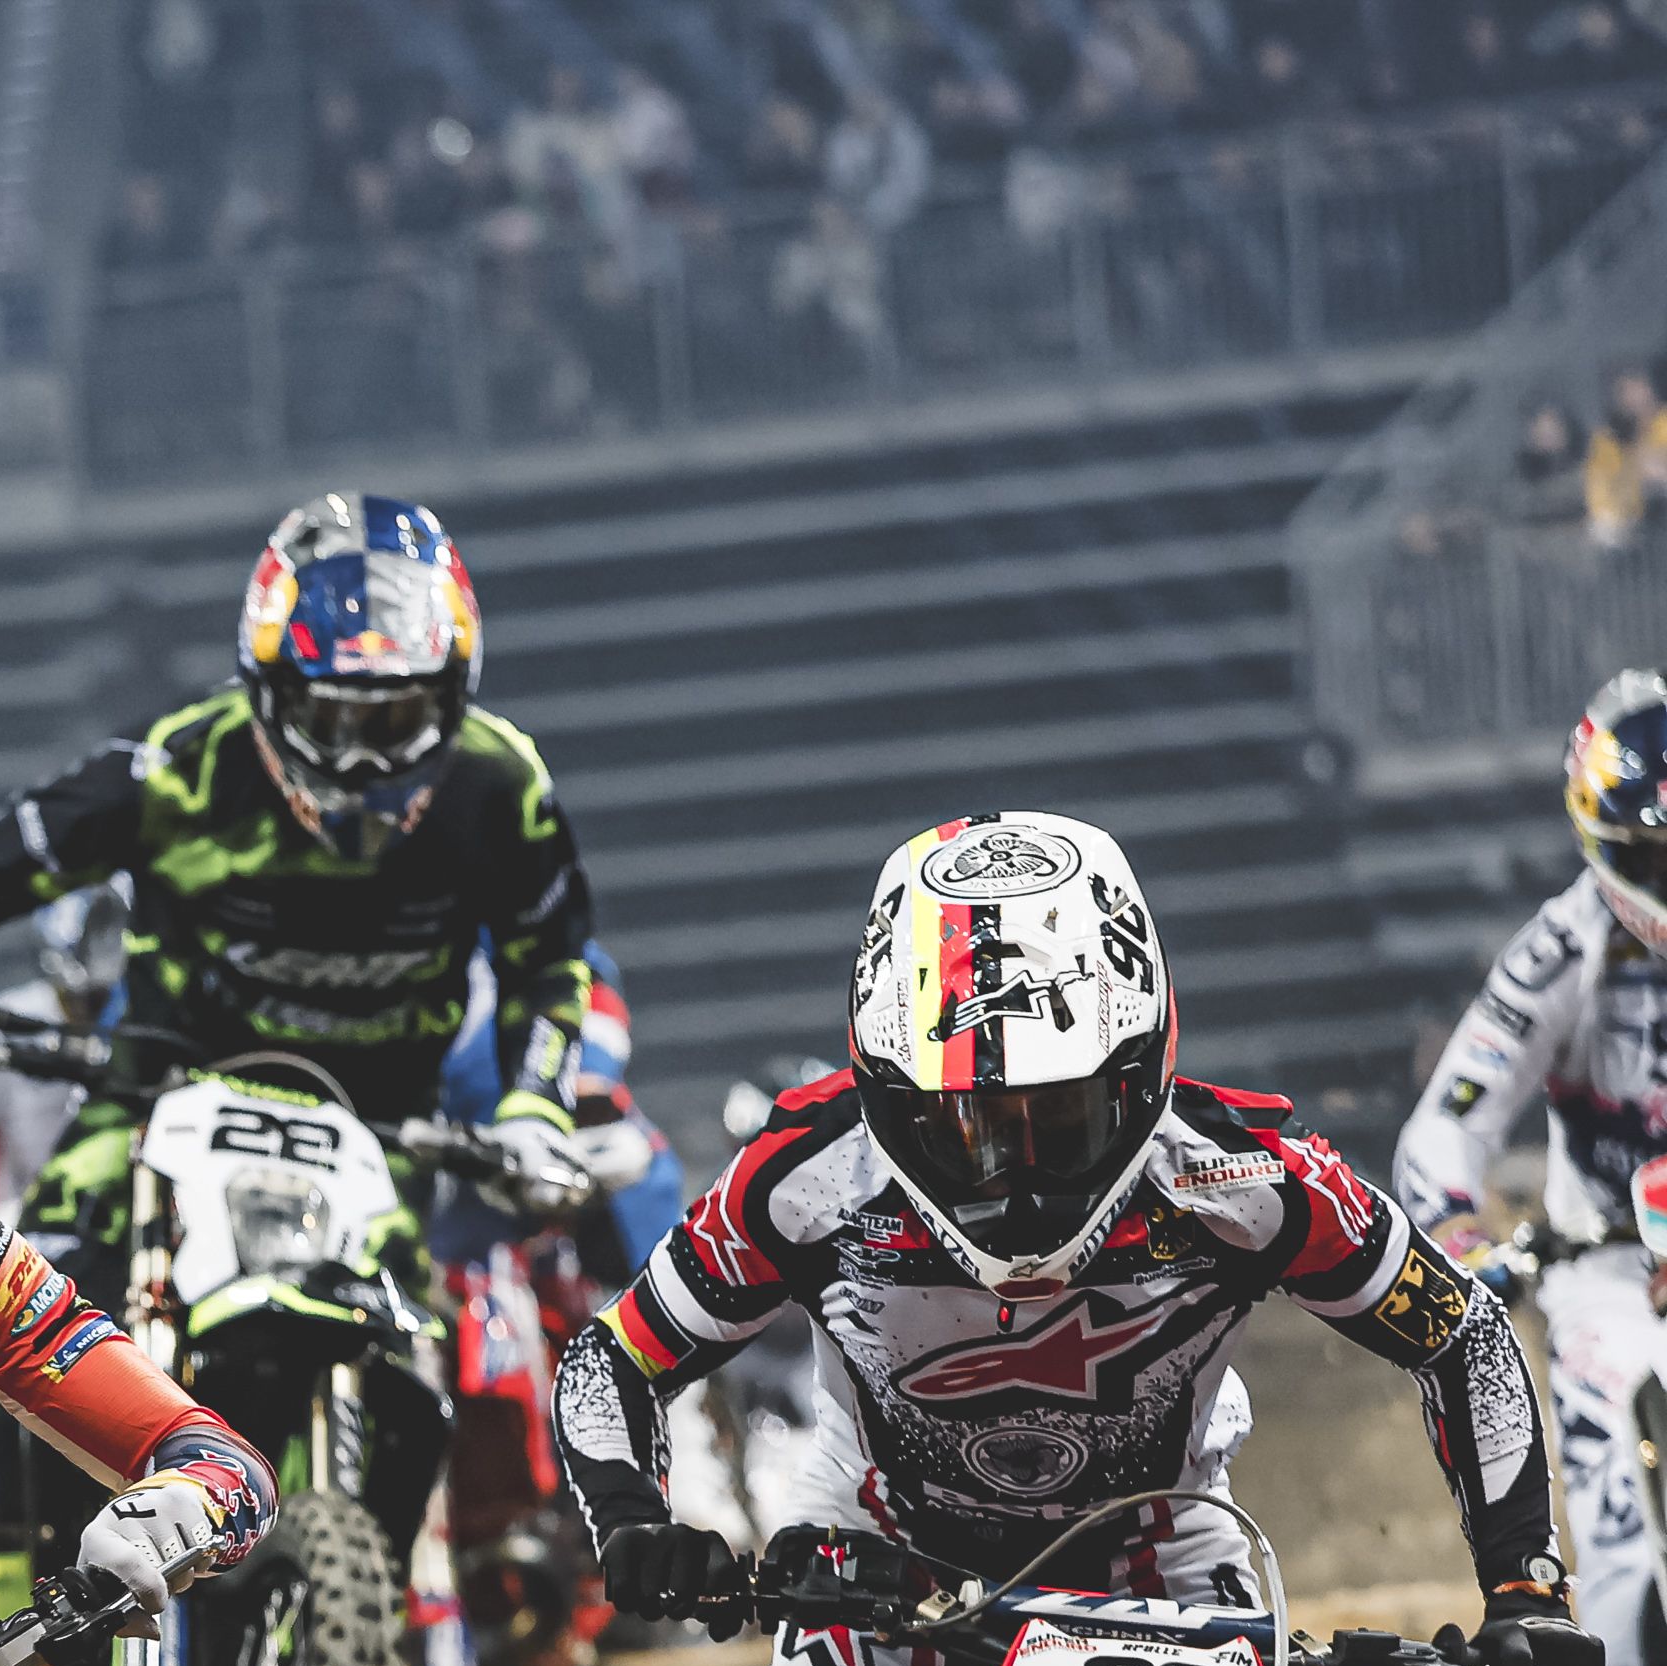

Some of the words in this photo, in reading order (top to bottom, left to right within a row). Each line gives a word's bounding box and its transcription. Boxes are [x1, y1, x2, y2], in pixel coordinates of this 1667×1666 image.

[210, 1105, 340, 1172] 22
[1173, 1162, 1283, 1189] ENDURO
[1184, 1153, 1270, 1174] SUPER
[29, 1273, 66, 1314] MOTO
